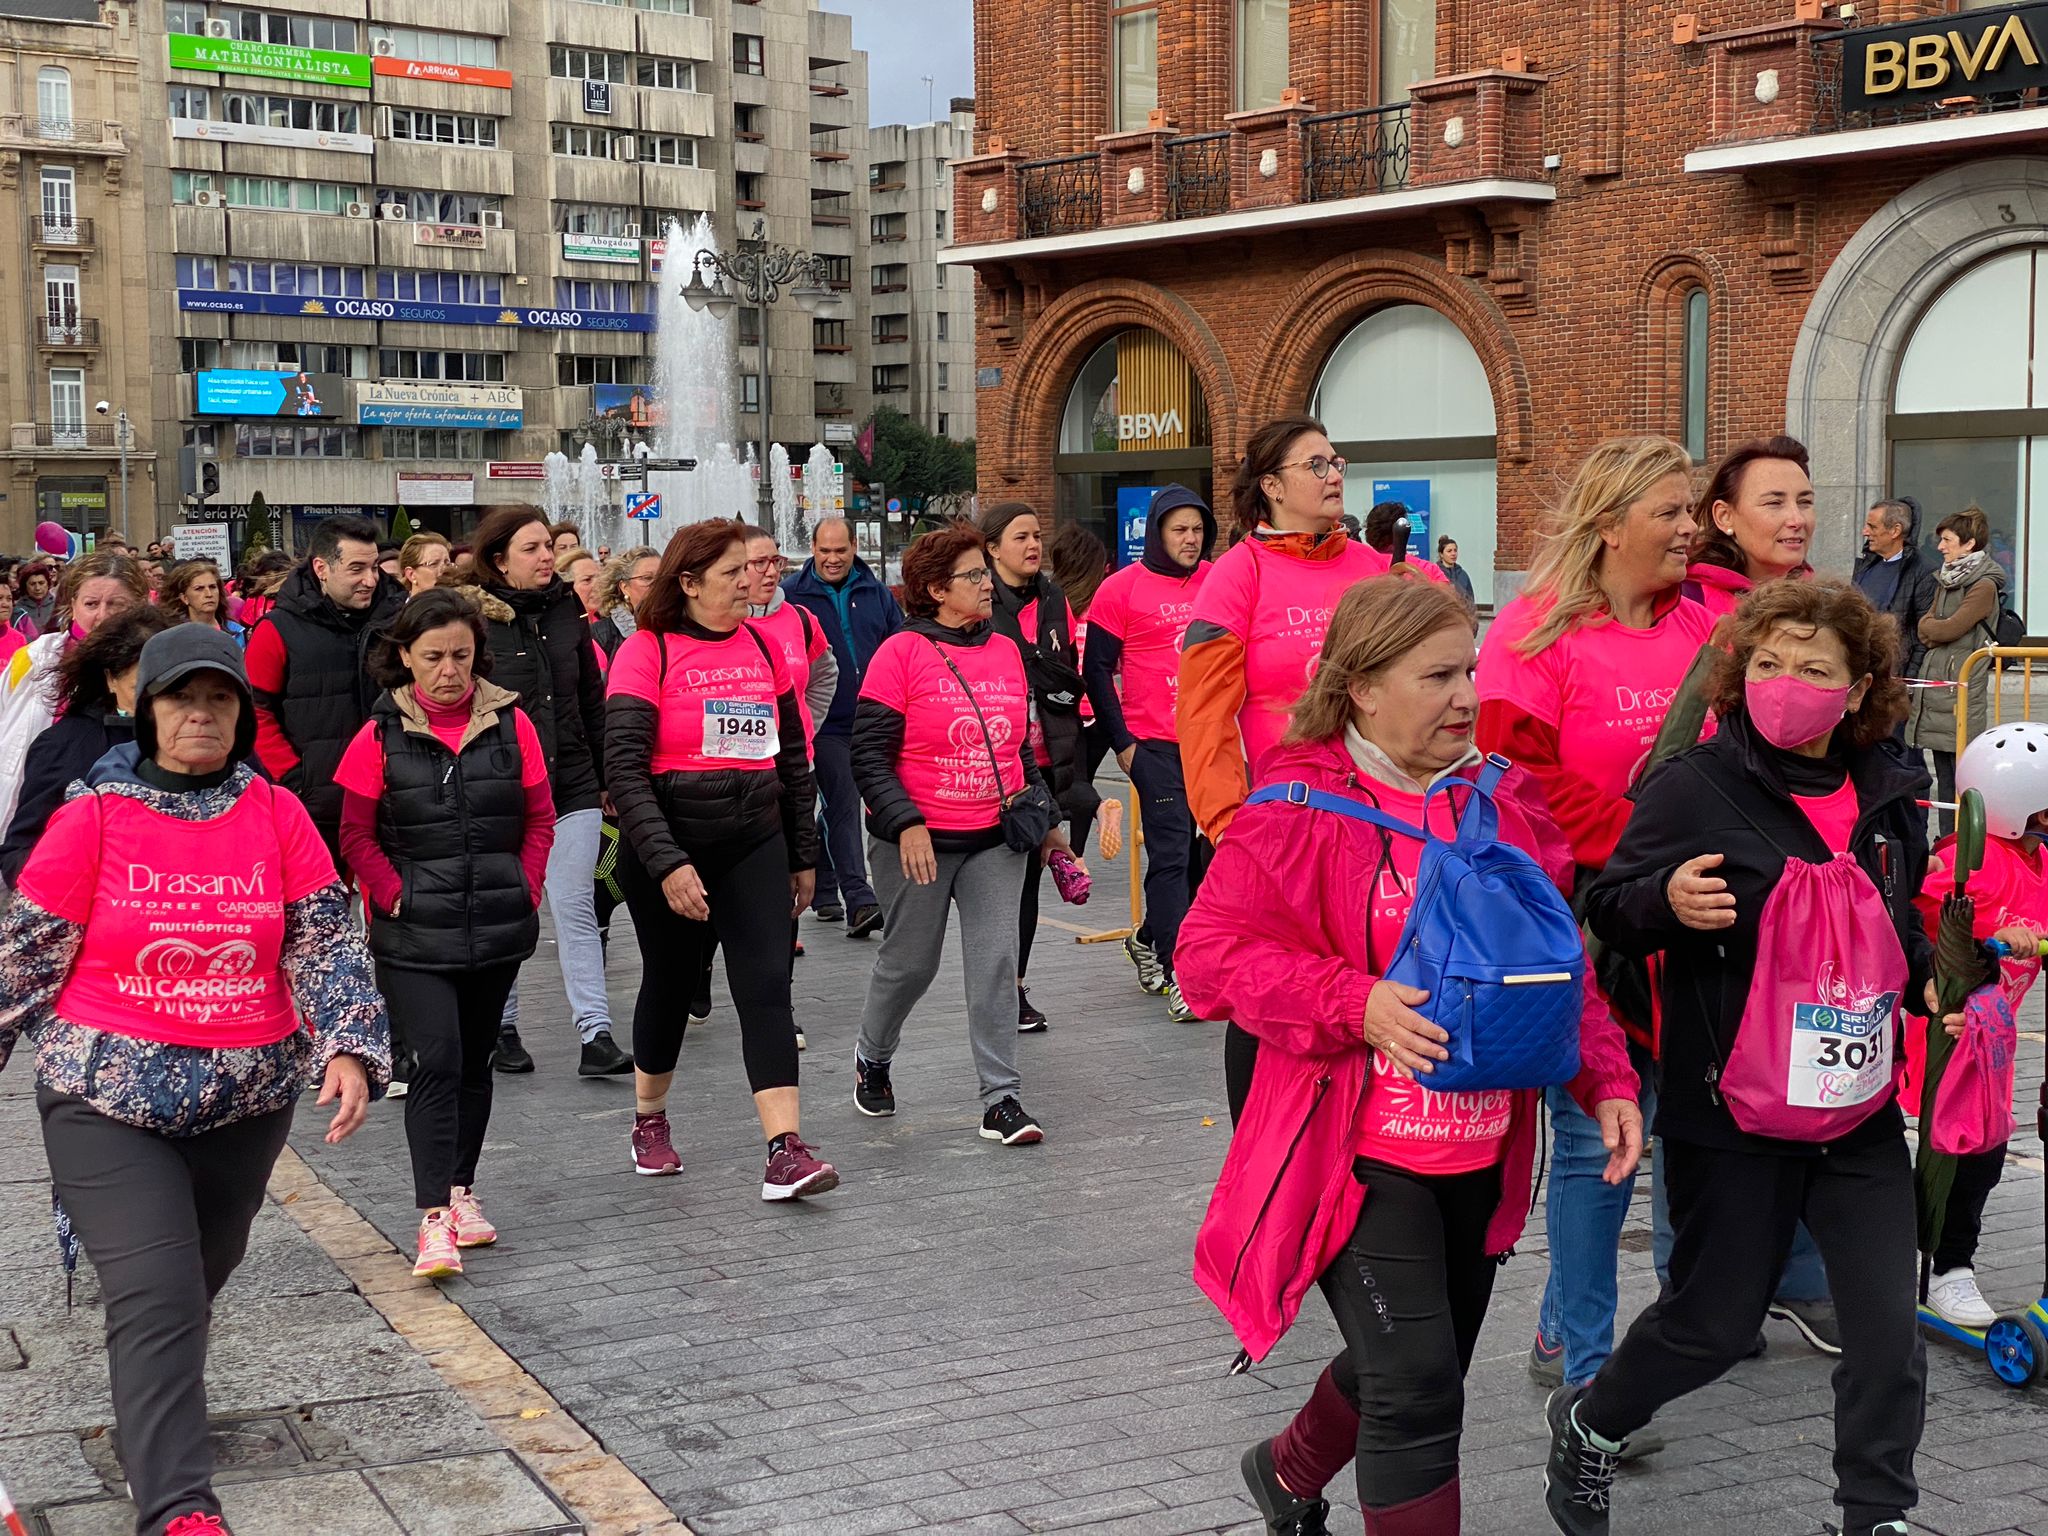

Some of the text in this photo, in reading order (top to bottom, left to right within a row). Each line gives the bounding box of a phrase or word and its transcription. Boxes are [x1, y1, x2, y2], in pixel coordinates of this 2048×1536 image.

[230, 42, 312, 59] CHARO LLAMERA
[1864, 15, 2039, 95] BBVA
[195, 48, 351, 75] MATRIMONIALISTA
[422, 65, 460, 77] ARRIAGA
[1998, 204, 2016, 223] 3
[590, 237, 633, 247] Abogados
[186, 299, 244, 310] www.ocaso.es
[335, 299, 446, 320] OCASO SEGUROS
[527, 310, 629, 329] OCASO SEGUROS
[369, 386, 382, 399] La
[385, 387, 417, 400] Nueva
[420, 387, 460, 402] Crónica
[486, 391, 516, 403] ABC
[362, 406, 519, 424] La mejor oferta informativa de León
[1119, 408, 1183, 440] BBVA
[303, 505, 362, 514] Phone House
[1159, 602, 1193, 617] Dras
[1286, 606, 1335, 626] Dras
[686, 660, 763, 687] Drasanvi
[1616, 686, 1679, 711] Drasa
[717, 717, 767, 737] 1948
[1606, 714, 1662, 727] VIGORE
[128, 861, 266, 896] Drasanvi
[111, 899, 283, 914] VIGOREE CAROBELS
[155, 977, 267, 998] CARRERA
[1817, 1025, 1884, 1071] 3031
[1381, 1119, 1451, 1140] ALMOM
